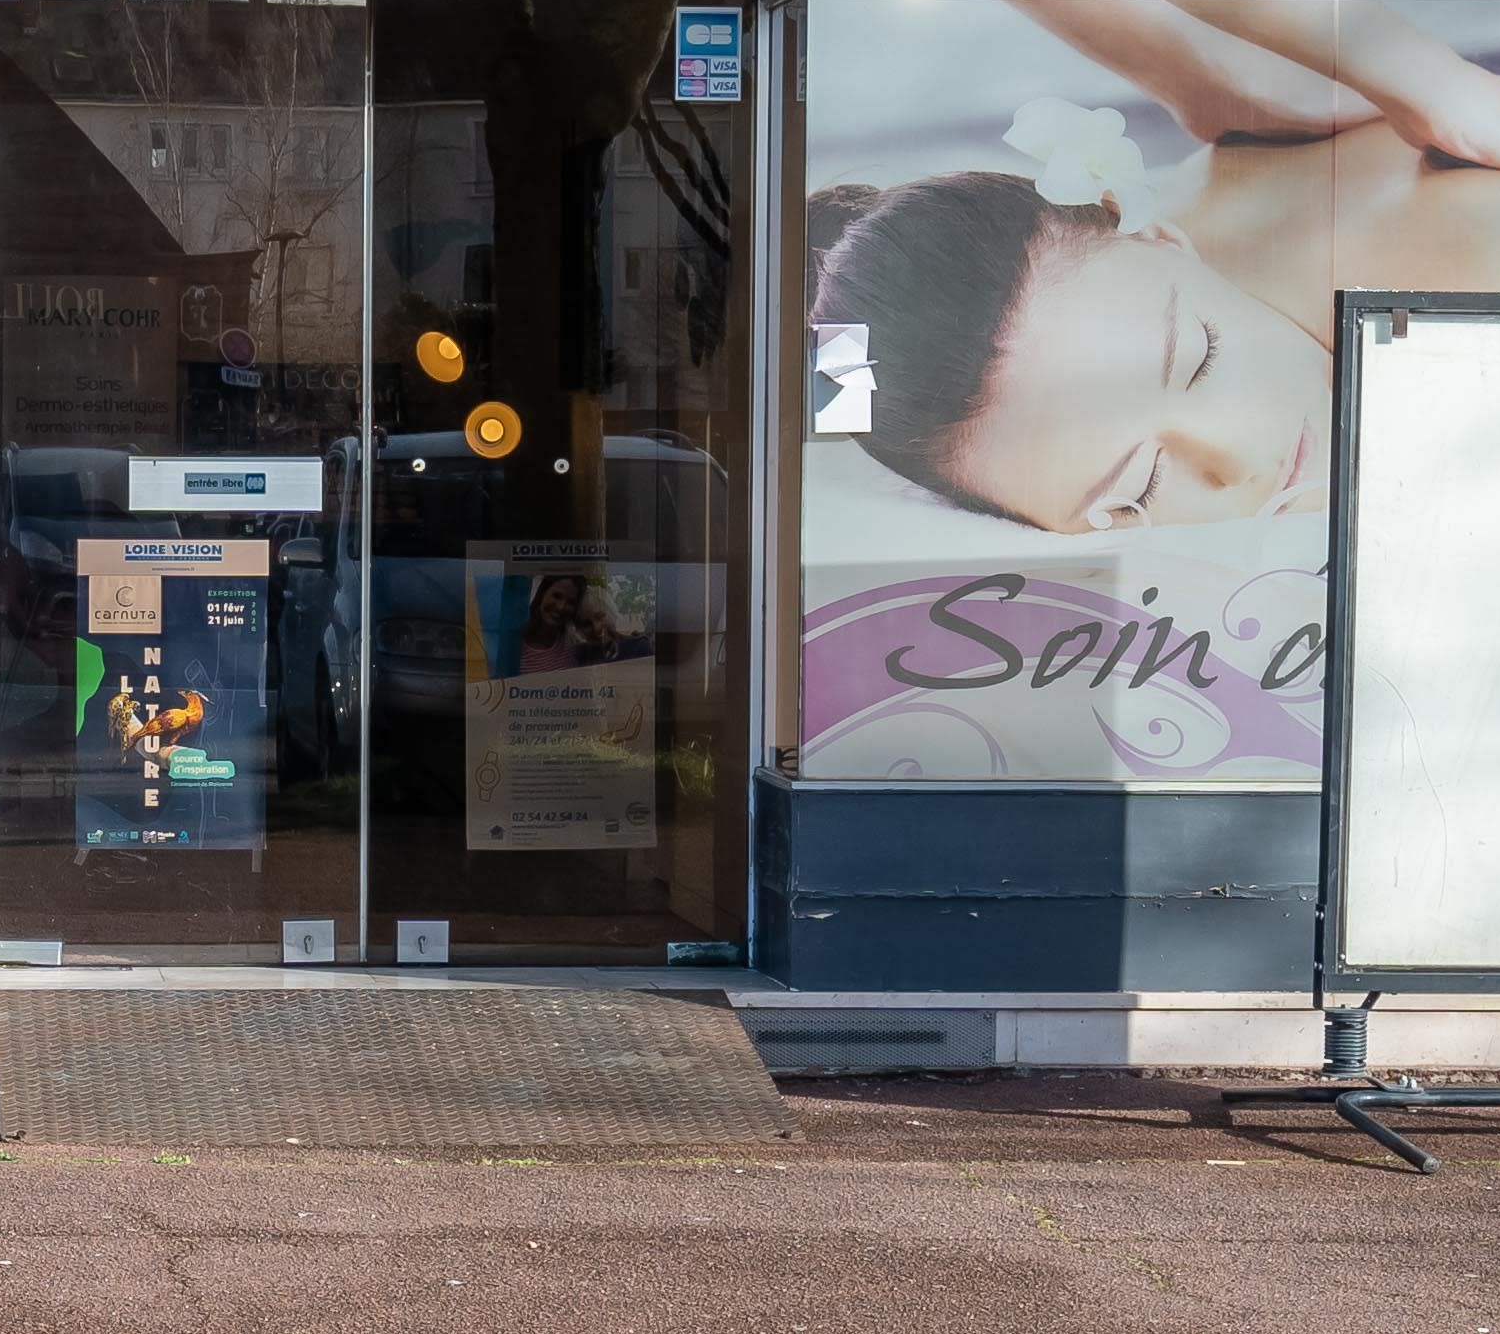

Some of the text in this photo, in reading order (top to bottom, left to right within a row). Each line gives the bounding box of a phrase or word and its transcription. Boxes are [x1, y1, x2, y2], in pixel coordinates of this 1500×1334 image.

[712, 60, 738, 71] VISA
[712, 81, 737, 91] VISA
[27, 308, 161, 328] MARY COHR
[76, 376, 121, 392] Soins
[187, 478, 244, 488] entrée libre
[124, 544, 222, 555] LOIRE VISION
[511, 545, 609, 556] LOIRE VISION
[207, 589, 257, 597] EXPOSITION
[206, 602, 245, 613] 01 févr
[207, 615, 245, 628] 21 juin
[884, 573, 1218, 690] Soin
[508, 685, 593, 700] Dom@dom
[508, 708, 526, 718] ma
[508, 720, 579, 734] de proximité
[173, 754, 204, 764] source
[173, 764, 229, 776] d'inspiration
[511, 811, 525, 822] 02
[527, 811, 541, 822] 54
